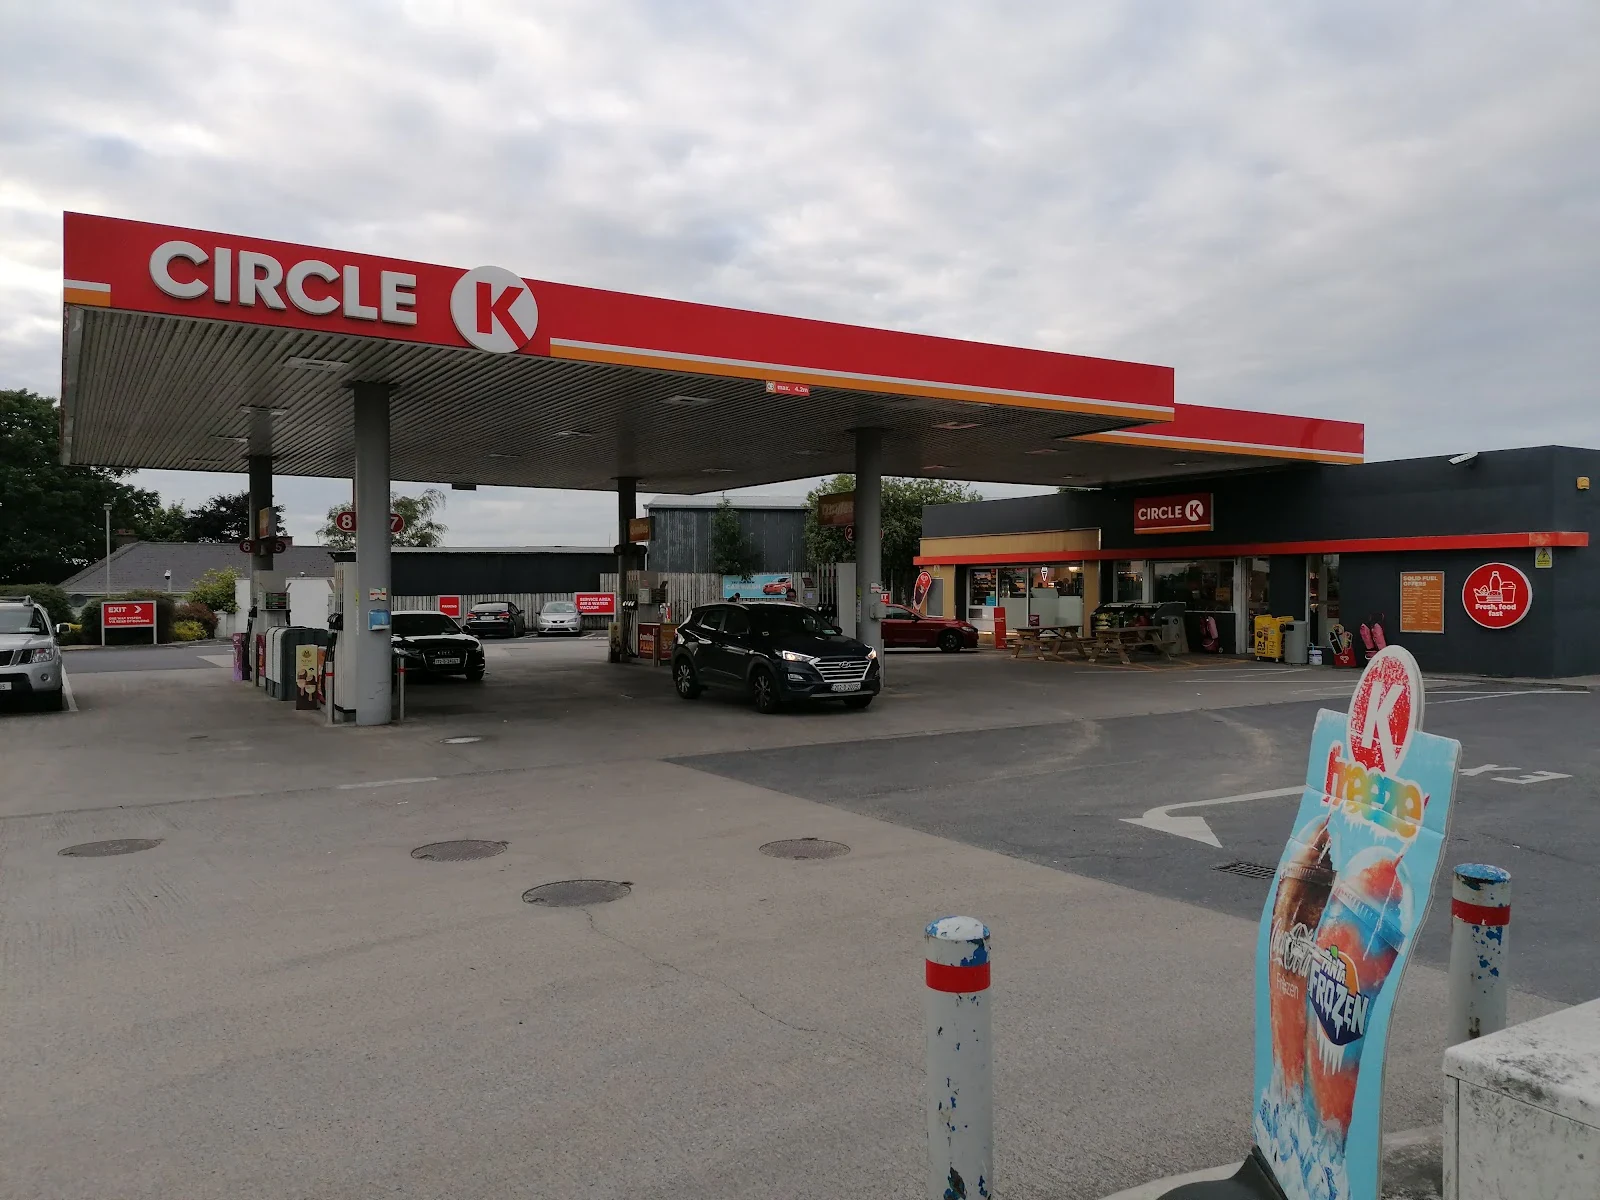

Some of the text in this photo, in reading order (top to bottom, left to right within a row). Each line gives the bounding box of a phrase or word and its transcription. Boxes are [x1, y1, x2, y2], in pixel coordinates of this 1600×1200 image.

[148, 240, 532, 351] CIRCLE K
[1138, 502, 1203, 520] CIRCLE K
[341, 514, 352, 528] 8
[391, 516, 399, 529] 7
[847, 528, 853, 539] 2
[242, 542, 250, 552] 6
[275, 541, 283, 552] 5
[1475, 603, 1498, 611] Fresh,
[1361, 680, 1405, 774] K
[1309, 959, 1370, 1040] FROZEN
